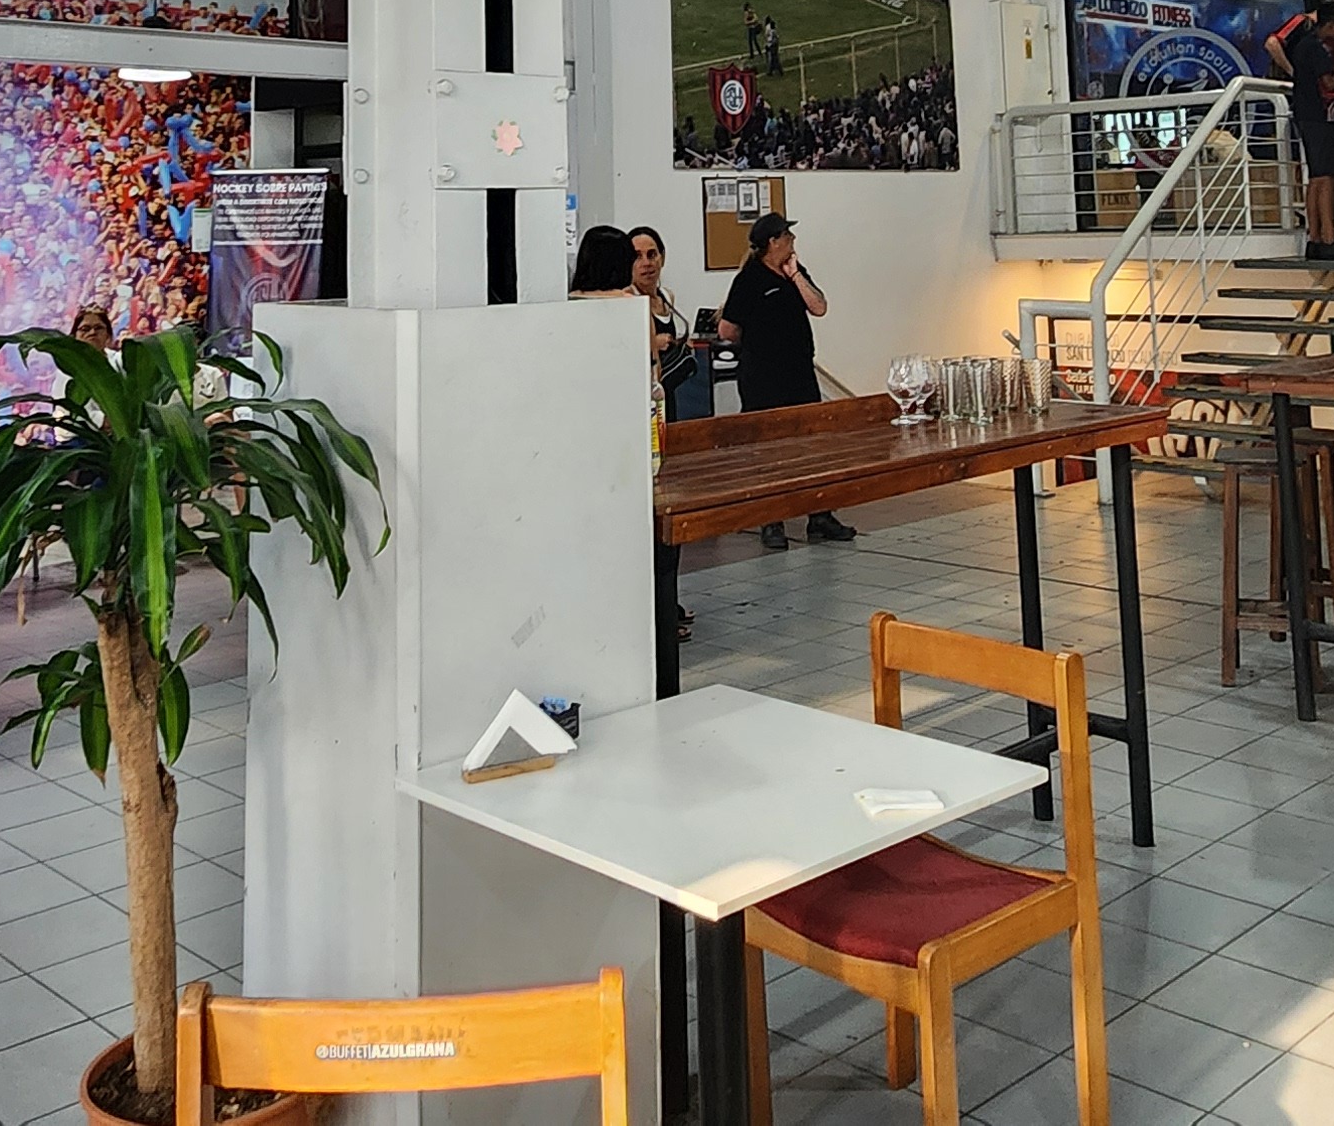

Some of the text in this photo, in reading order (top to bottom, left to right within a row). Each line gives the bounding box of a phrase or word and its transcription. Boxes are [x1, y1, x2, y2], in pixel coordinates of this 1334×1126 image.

[1199, 45, 1234, 75] sport
[213, 183, 254, 193] HOCKEY
[370, 1041, 455, 1059] AZULGRANA
